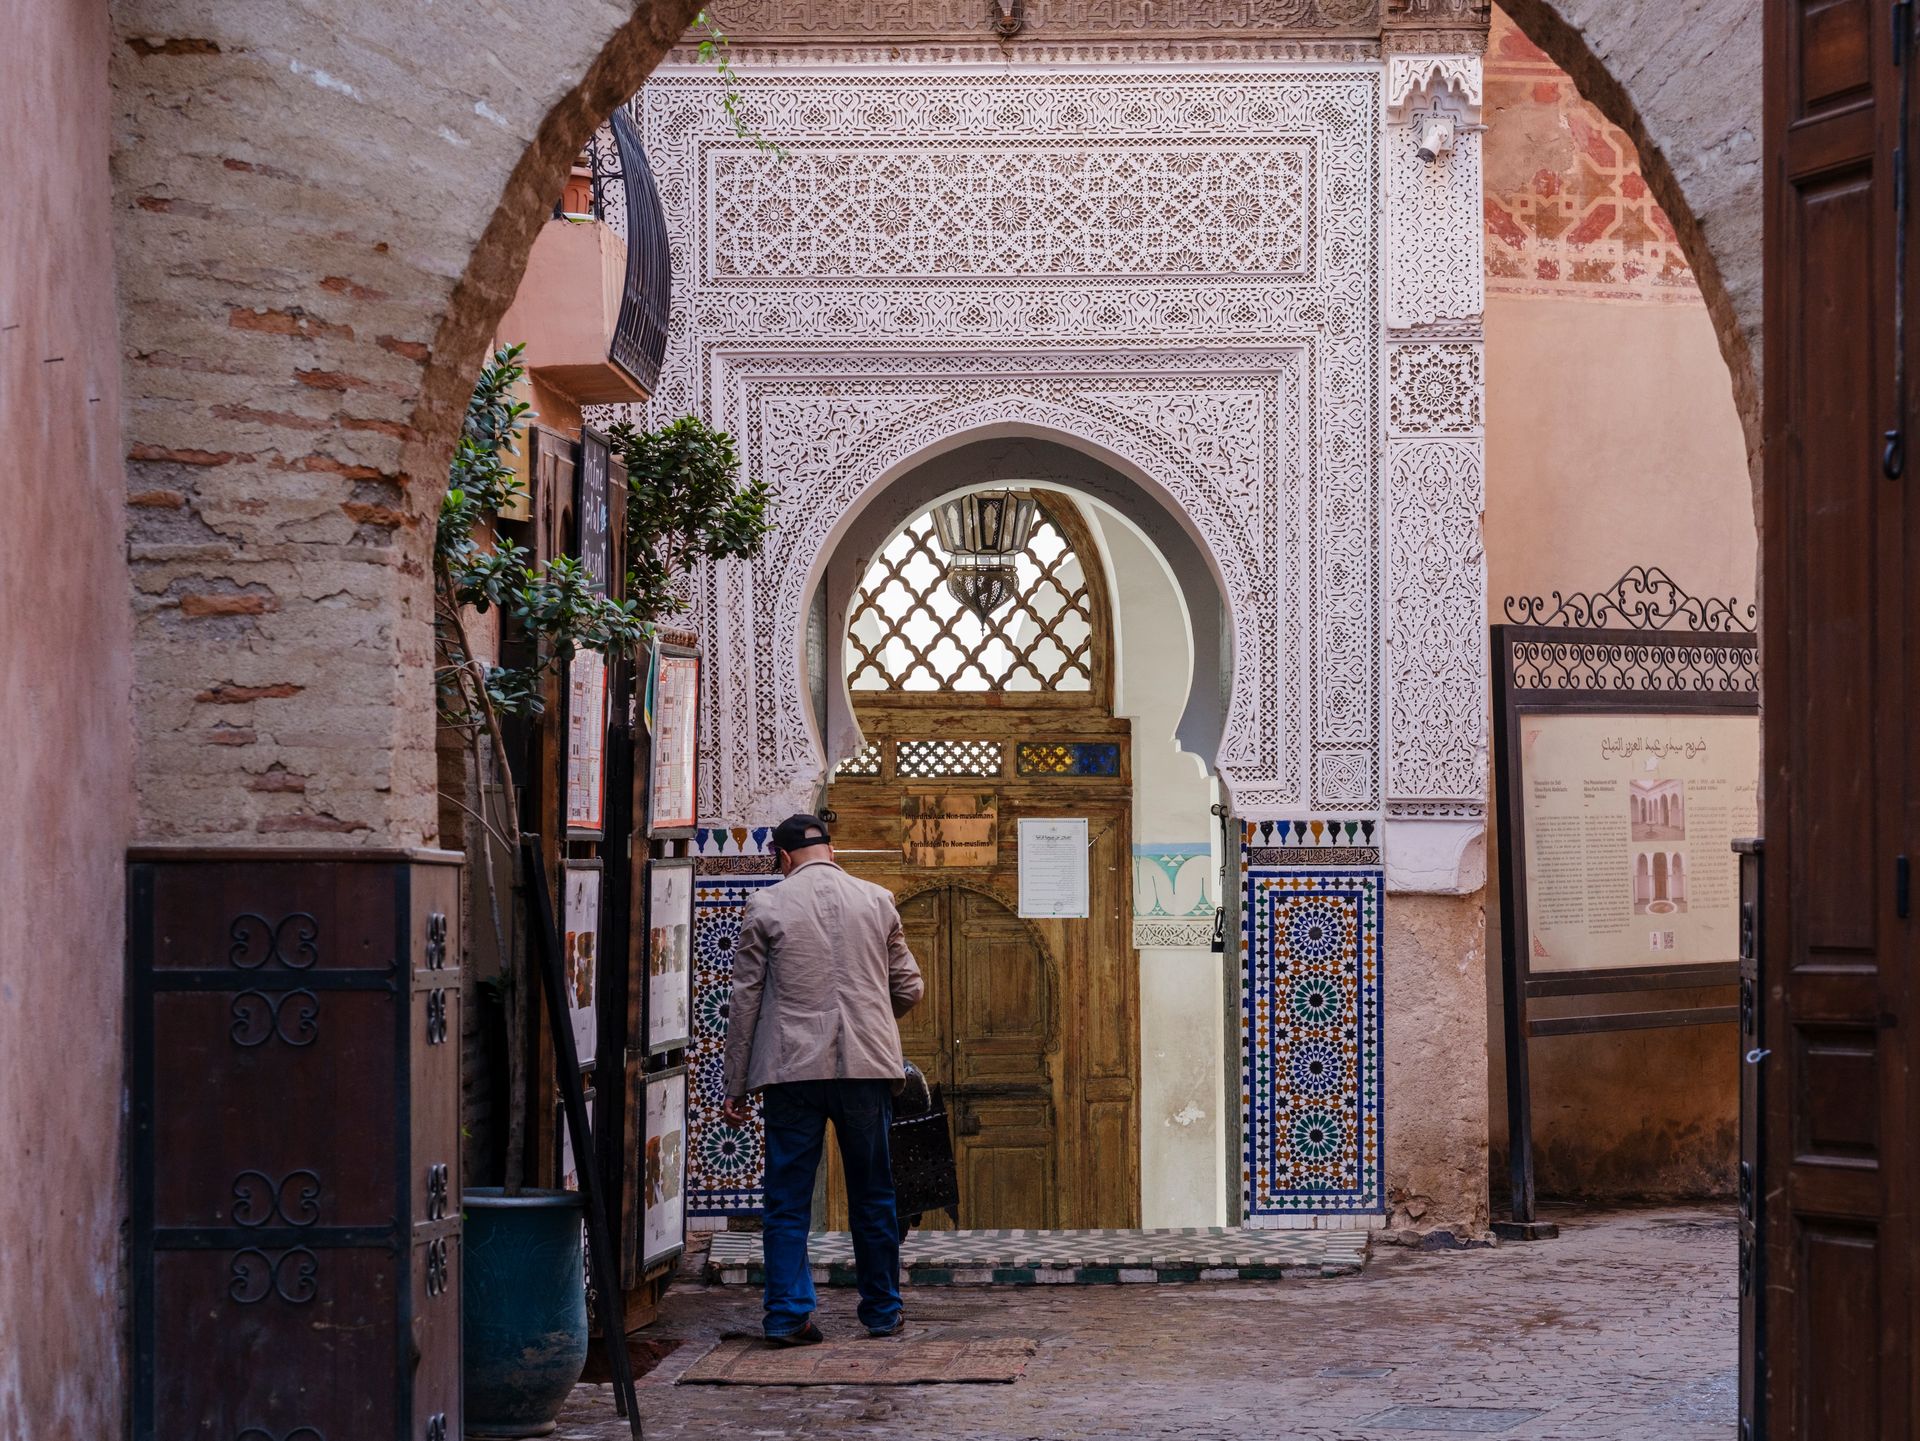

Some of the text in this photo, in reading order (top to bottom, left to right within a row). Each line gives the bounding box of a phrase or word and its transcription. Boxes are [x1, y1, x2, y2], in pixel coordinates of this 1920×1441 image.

[1645, 737, 1661, 753] عبد
[946, 812, 994, 820] Non-musulmans
[910, 840, 990, 848] Forbidden To Non-muslims
